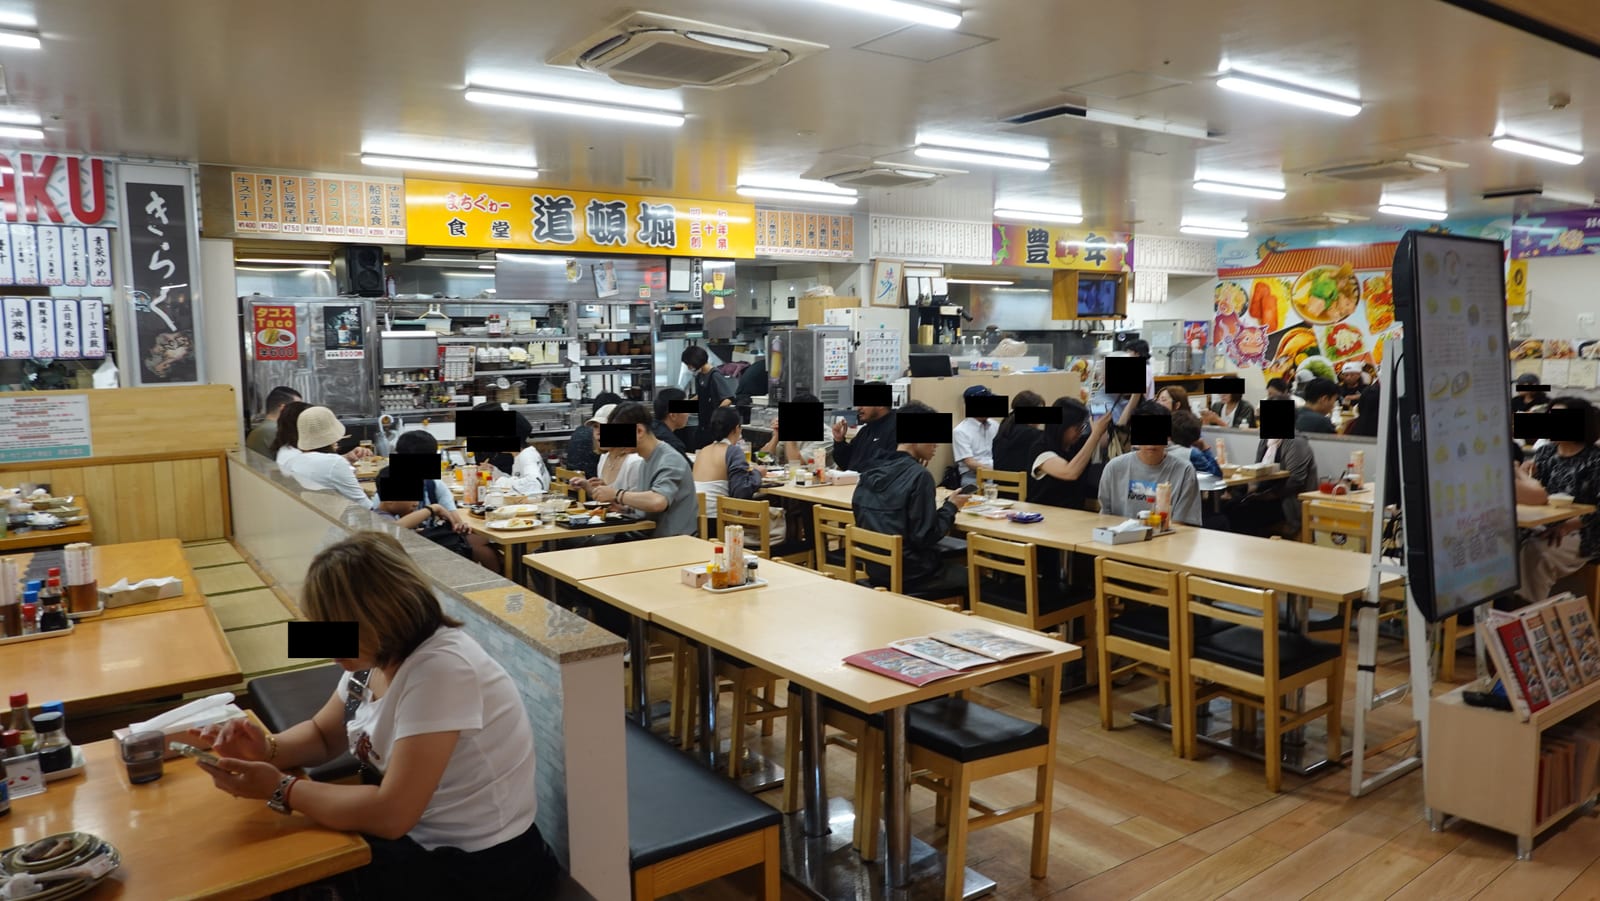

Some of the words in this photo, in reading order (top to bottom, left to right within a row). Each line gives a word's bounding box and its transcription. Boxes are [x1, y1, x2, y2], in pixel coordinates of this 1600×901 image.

[237, 177, 253, 217] 牛ステーキ
[260, 178, 273, 219] 漬けマグロ丼
[283, 179, 298, 222] ゆし豆腐そば
[329, 183, 339, 222] タコス
[369, 185, 382, 225] 船盛定食
[238, 221, 257, 230] ¥1400
[447, 218, 510, 238] 食堂
[533, 196, 675, 247] 道頓堀
[691, 223, 727, 234] 三十年
[145, 191, 178, 331] きらく
[691, 236, 727, 248] 創業
[1026, 228, 1106, 266] 豊年
[256, 308, 293, 317] タコス
[256, 318, 293, 328] Taco
